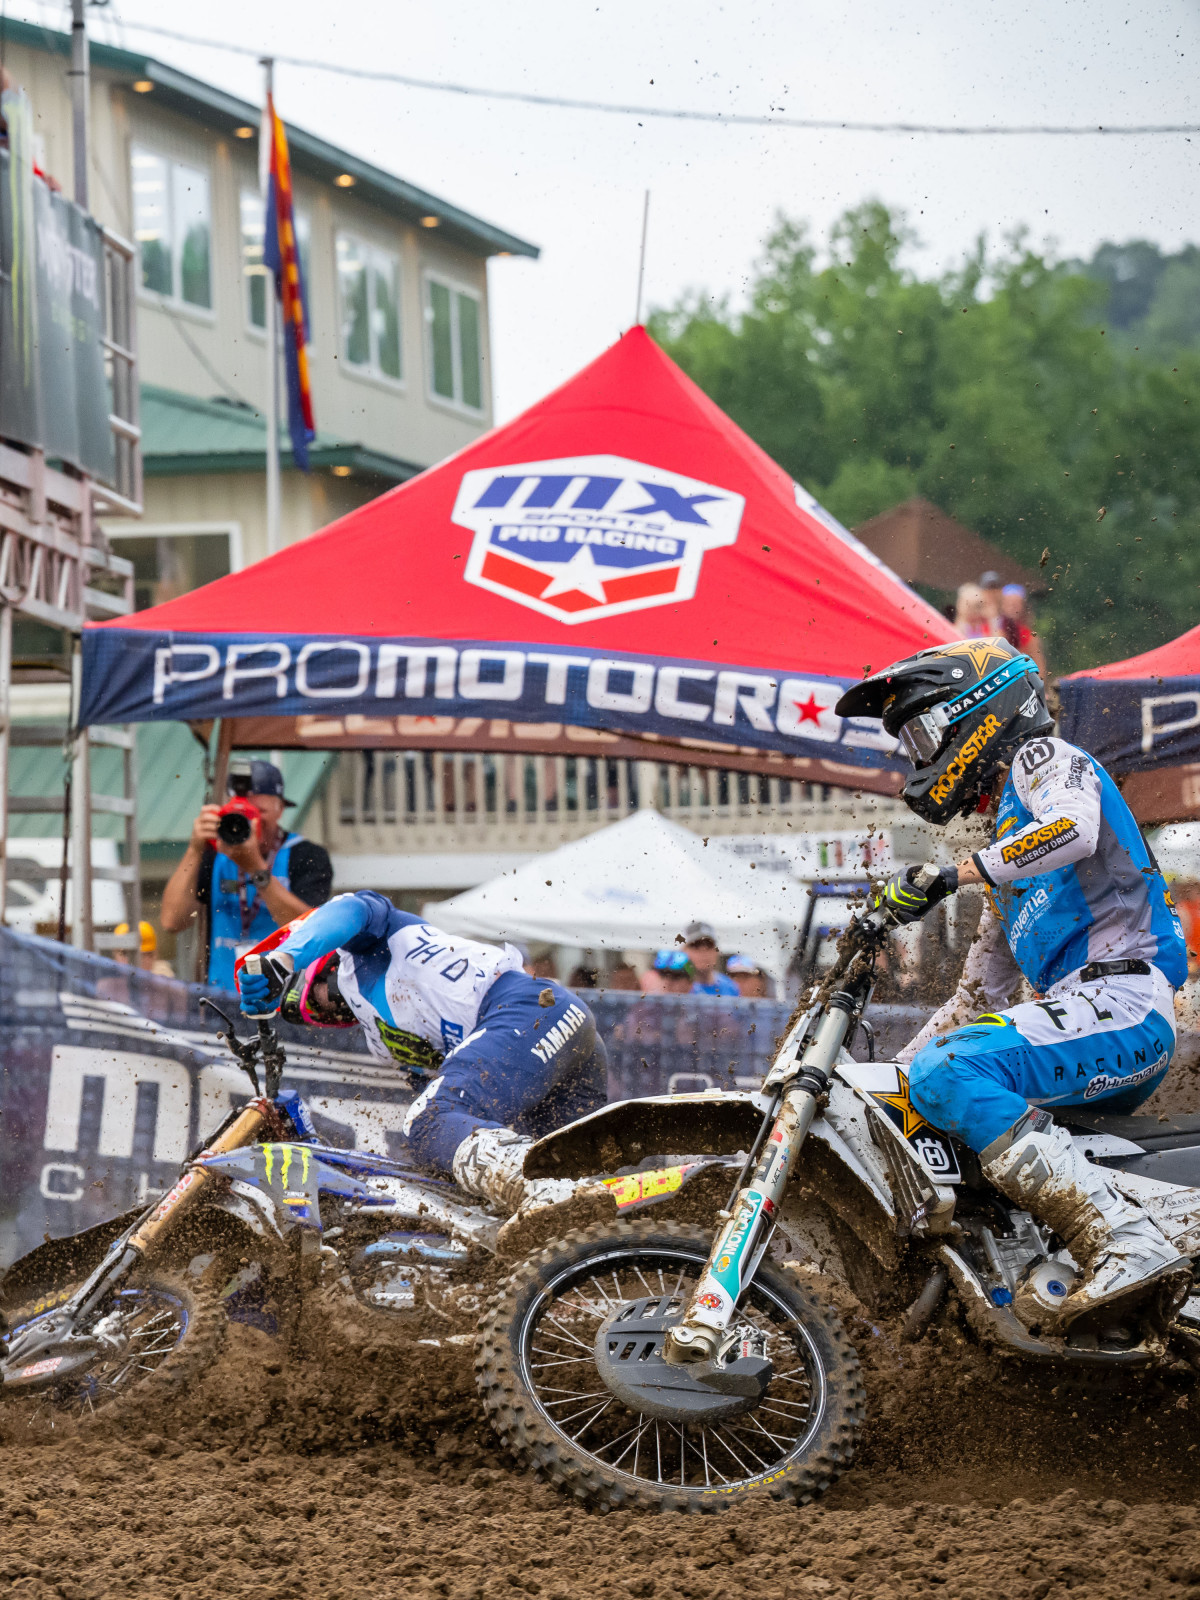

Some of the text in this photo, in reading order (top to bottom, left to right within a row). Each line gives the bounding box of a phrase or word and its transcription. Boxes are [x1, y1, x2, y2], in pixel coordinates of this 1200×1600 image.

[498, 526, 679, 556] PRO RACING
[951, 668, 1011, 715] OAKLEY
[928, 713, 1002, 806] ROCKSTAR
[1002, 816, 1078, 864] ROCKSTAR
[1016, 829, 1079, 868] ENERGY DRINK
[531, 1003, 586, 1064] YAMAHA
[1054, 1037, 1164, 1082] RACING
[1107, 1051, 1168, 1089] Husqvarna
